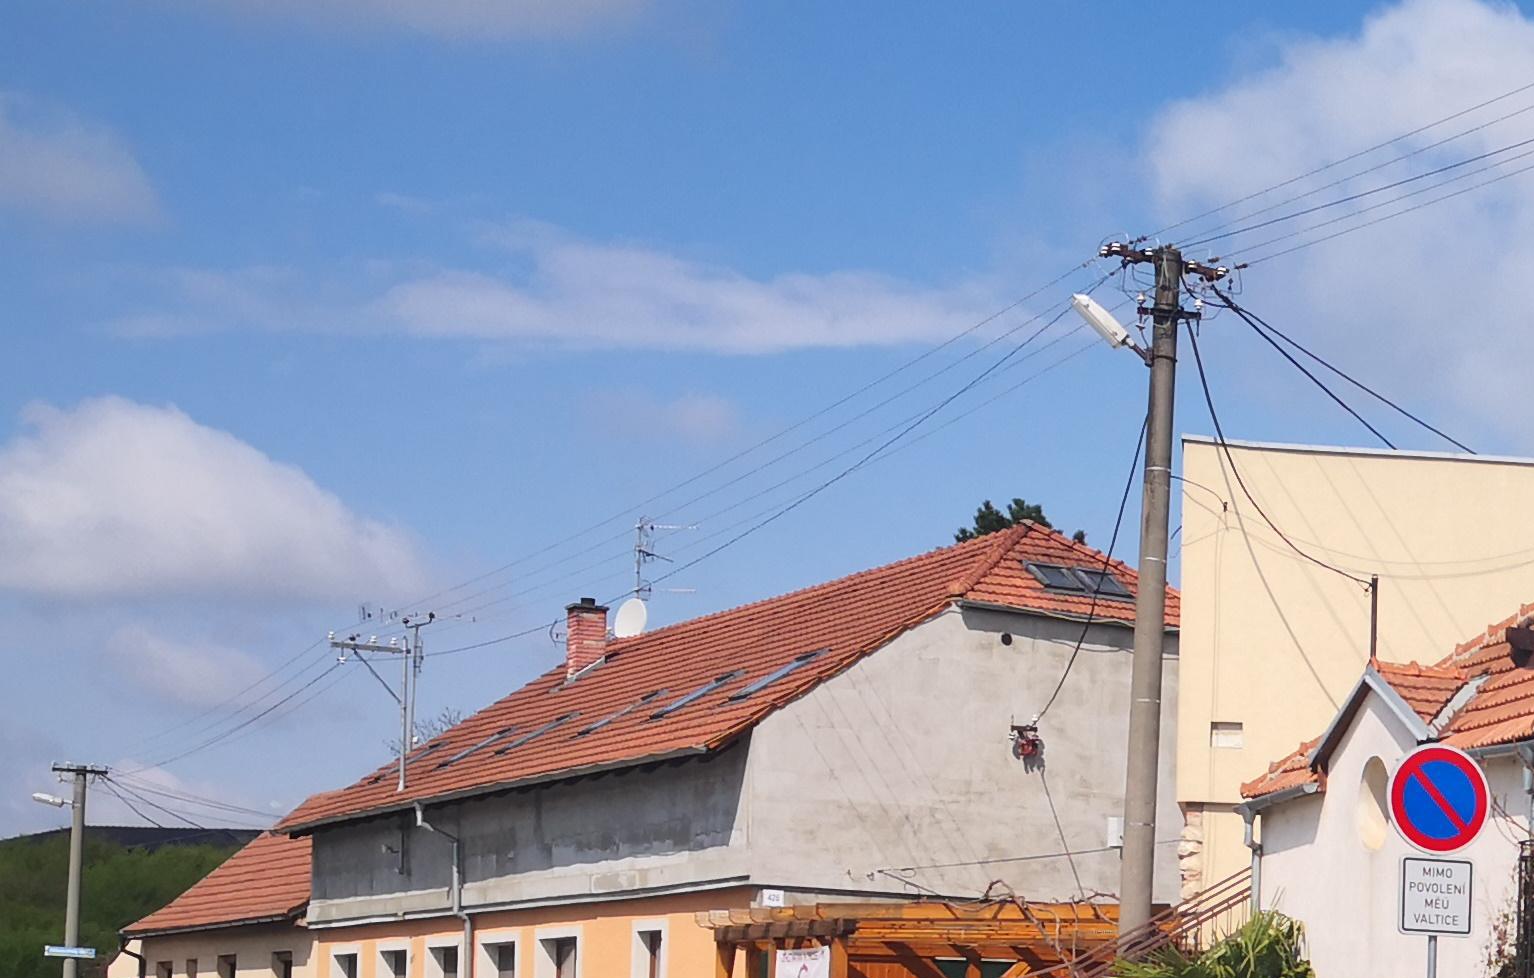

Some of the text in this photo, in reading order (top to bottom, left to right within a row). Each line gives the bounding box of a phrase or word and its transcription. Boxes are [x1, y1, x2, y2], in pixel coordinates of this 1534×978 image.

[1422, 866, 1453, 879] MIMO
[1409, 881, 1466, 895] POVOLENÍ
[1413, 912, 1459, 926] VALTICE
